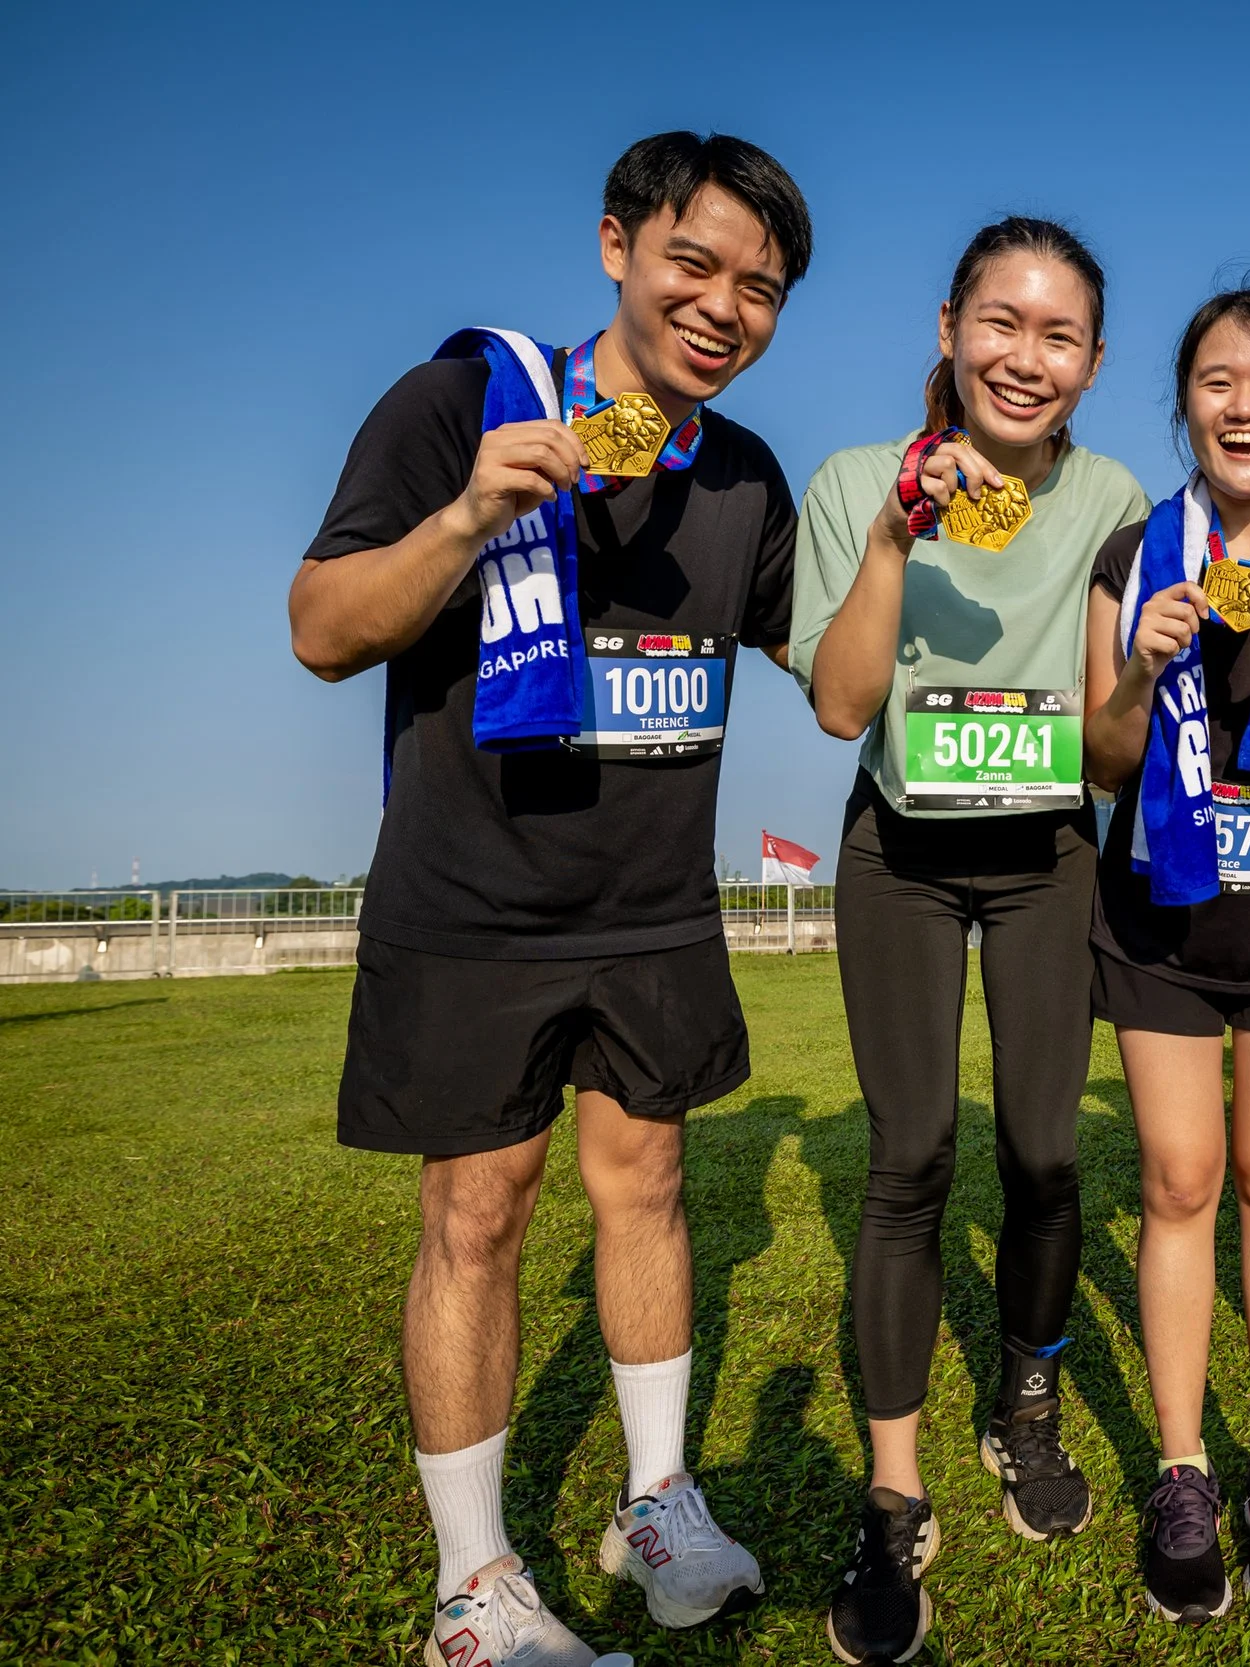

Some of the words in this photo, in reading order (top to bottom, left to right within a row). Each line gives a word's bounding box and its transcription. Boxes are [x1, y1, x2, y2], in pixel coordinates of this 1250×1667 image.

[951, 507, 983, 533] RUN
[481, 546, 564, 644] UN
[1209, 578, 1239, 600] RUN
[593, 636, 624, 650] SG
[703, 638, 714, 646] 10
[701, 645, 714, 654] km
[478, 639, 569, 680] GAPORE
[605, 667, 707, 715] 10100
[926, 694, 953, 706] SG
[1046, 696, 1056, 704] 5
[1039, 702, 1061, 712] km
[639, 717, 689, 729] TERENCE
[934, 722, 1052, 768] 50241
[975, 770, 1012, 781] Zanna
[1217, 859, 1240, 869] race
